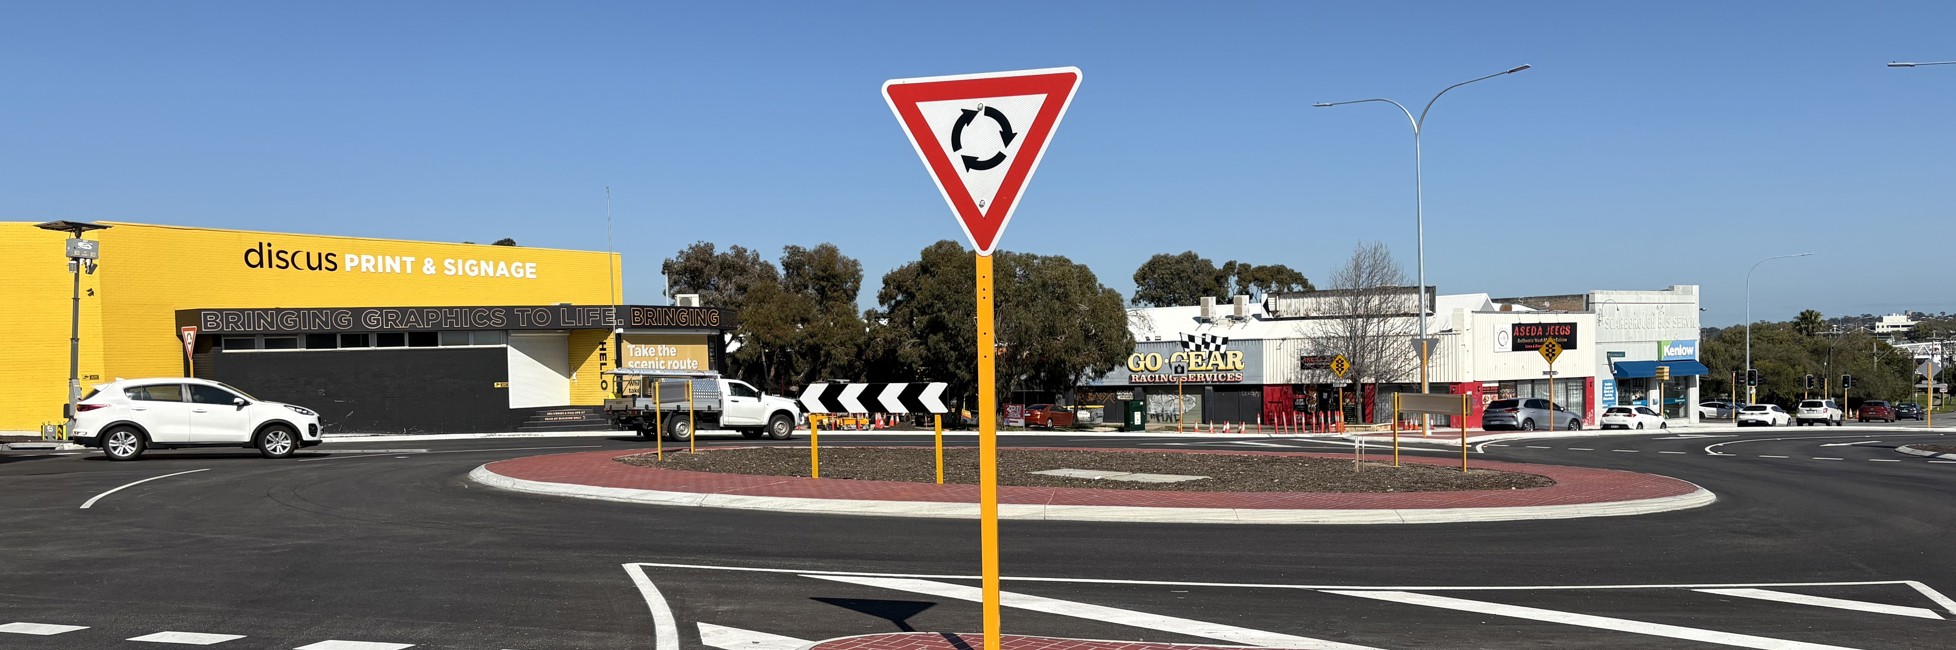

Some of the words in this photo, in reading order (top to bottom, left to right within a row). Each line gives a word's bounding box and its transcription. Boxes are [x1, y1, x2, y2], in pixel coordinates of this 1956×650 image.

[244, 241, 338, 272] discus
[344, 253, 416, 275] PRINT
[422, 257, 437, 275] &
[443, 258, 537, 279] SIGNAGE
[201, 309, 353, 331] BRINGING
[361, 307, 507, 330] GRAPHICS
[514, 307, 552, 327] TO
[560, 307, 625, 326] LIFE.
[631, 307, 720, 327] BRINGING
[1513, 325, 1543, 337] ASEDA
[627, 344, 656, 357] Take
[657, 344, 677, 357] the
[1664, 344, 1695, 357] Kenlow
[598, 341, 608, 391] HELLO
[628, 357, 666, 369] scenic
[667, 357, 699, 370] route
[1131, 373, 1180, 383] RACING
[1181, 372, 1244, 383] SERVICES
